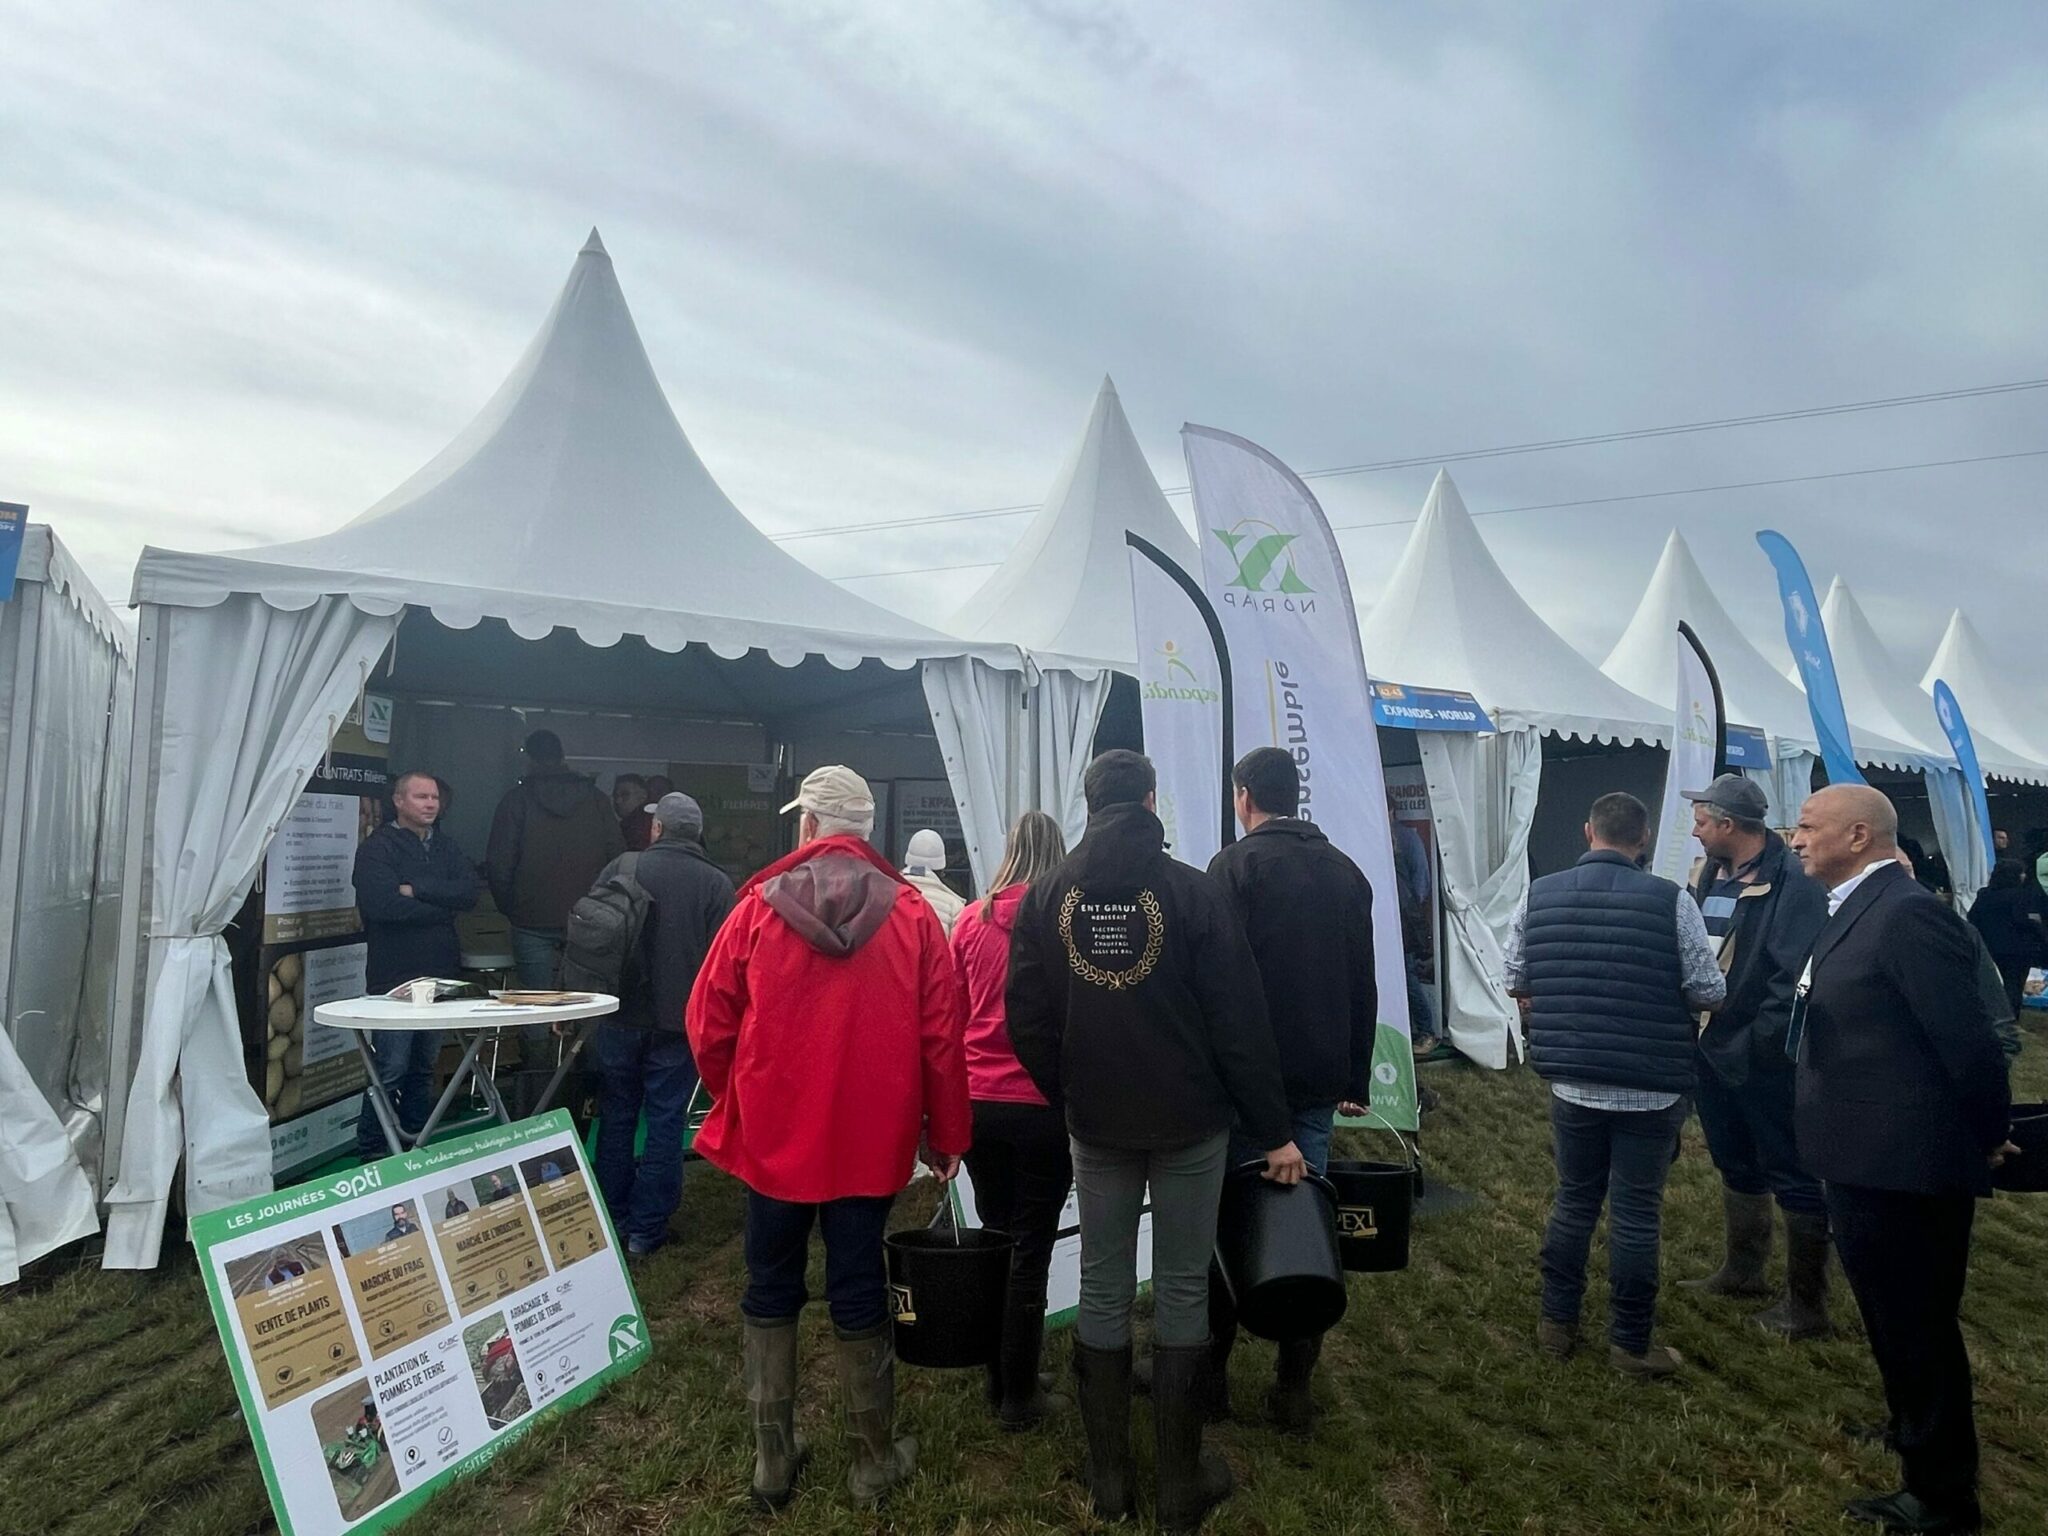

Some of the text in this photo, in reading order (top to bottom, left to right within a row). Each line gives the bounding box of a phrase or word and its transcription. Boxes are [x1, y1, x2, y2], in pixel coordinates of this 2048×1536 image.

[1382, 704, 1434, 719] EXPANDIS
[1440, 709, 1477, 721] NORIAP
[315, 765, 363, 782] CONTRATS
[1081, 904, 1137, 912] ENT GRAUX
[404, 1159, 422, 1172] Vos
[226, 1165, 383, 1230] LES JOURNÉES opti
[456, 1230, 483, 1252] MARCHÉ
[481, 1229, 491, 1243] DE
[360, 1257, 425, 1292] MARCHÉ DU FRAIS
[254, 1295, 331, 1336] VENTE DE PLANTS
[510, 1291, 551, 1320] ARRACHAGE DE
[513, 1314, 540, 1334] POMMES
[537, 1308, 546, 1323] DE
[545, 1300, 563, 1318] TERRE
[374, 1355, 420, 1388] PLANTATION
[419, 1350, 430, 1366] DE
[379, 1378, 414, 1405] POMMES
[412, 1373, 424, 1388] DE
[422, 1360, 446, 1381] TERRE
